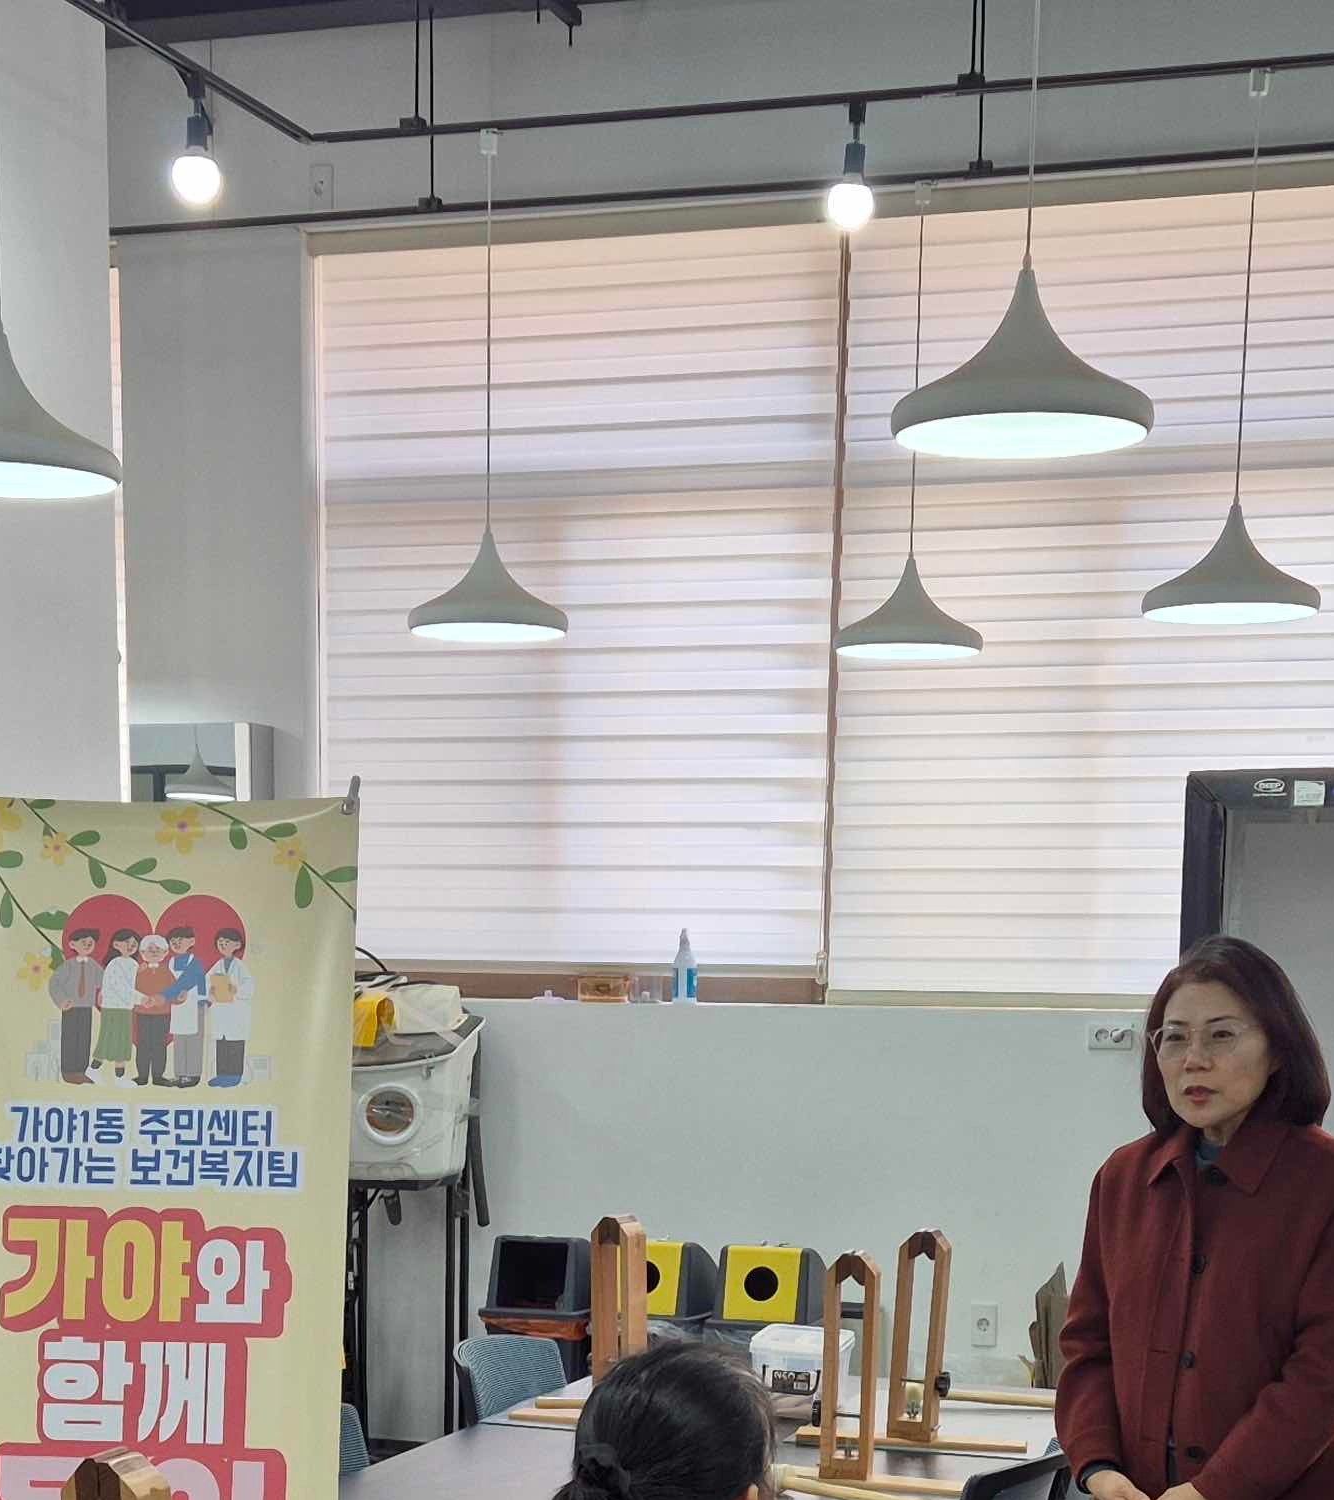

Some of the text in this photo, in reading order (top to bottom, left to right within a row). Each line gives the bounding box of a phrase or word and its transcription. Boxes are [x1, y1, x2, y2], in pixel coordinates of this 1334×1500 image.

[9, 1106, 274, 1148] 가야1동 주민센터
[129, 1148, 299, 1189] 보건복지팀
[0, 1215, 273, 1326] 가야와
[42, 1336, 229, 1446] 함께
